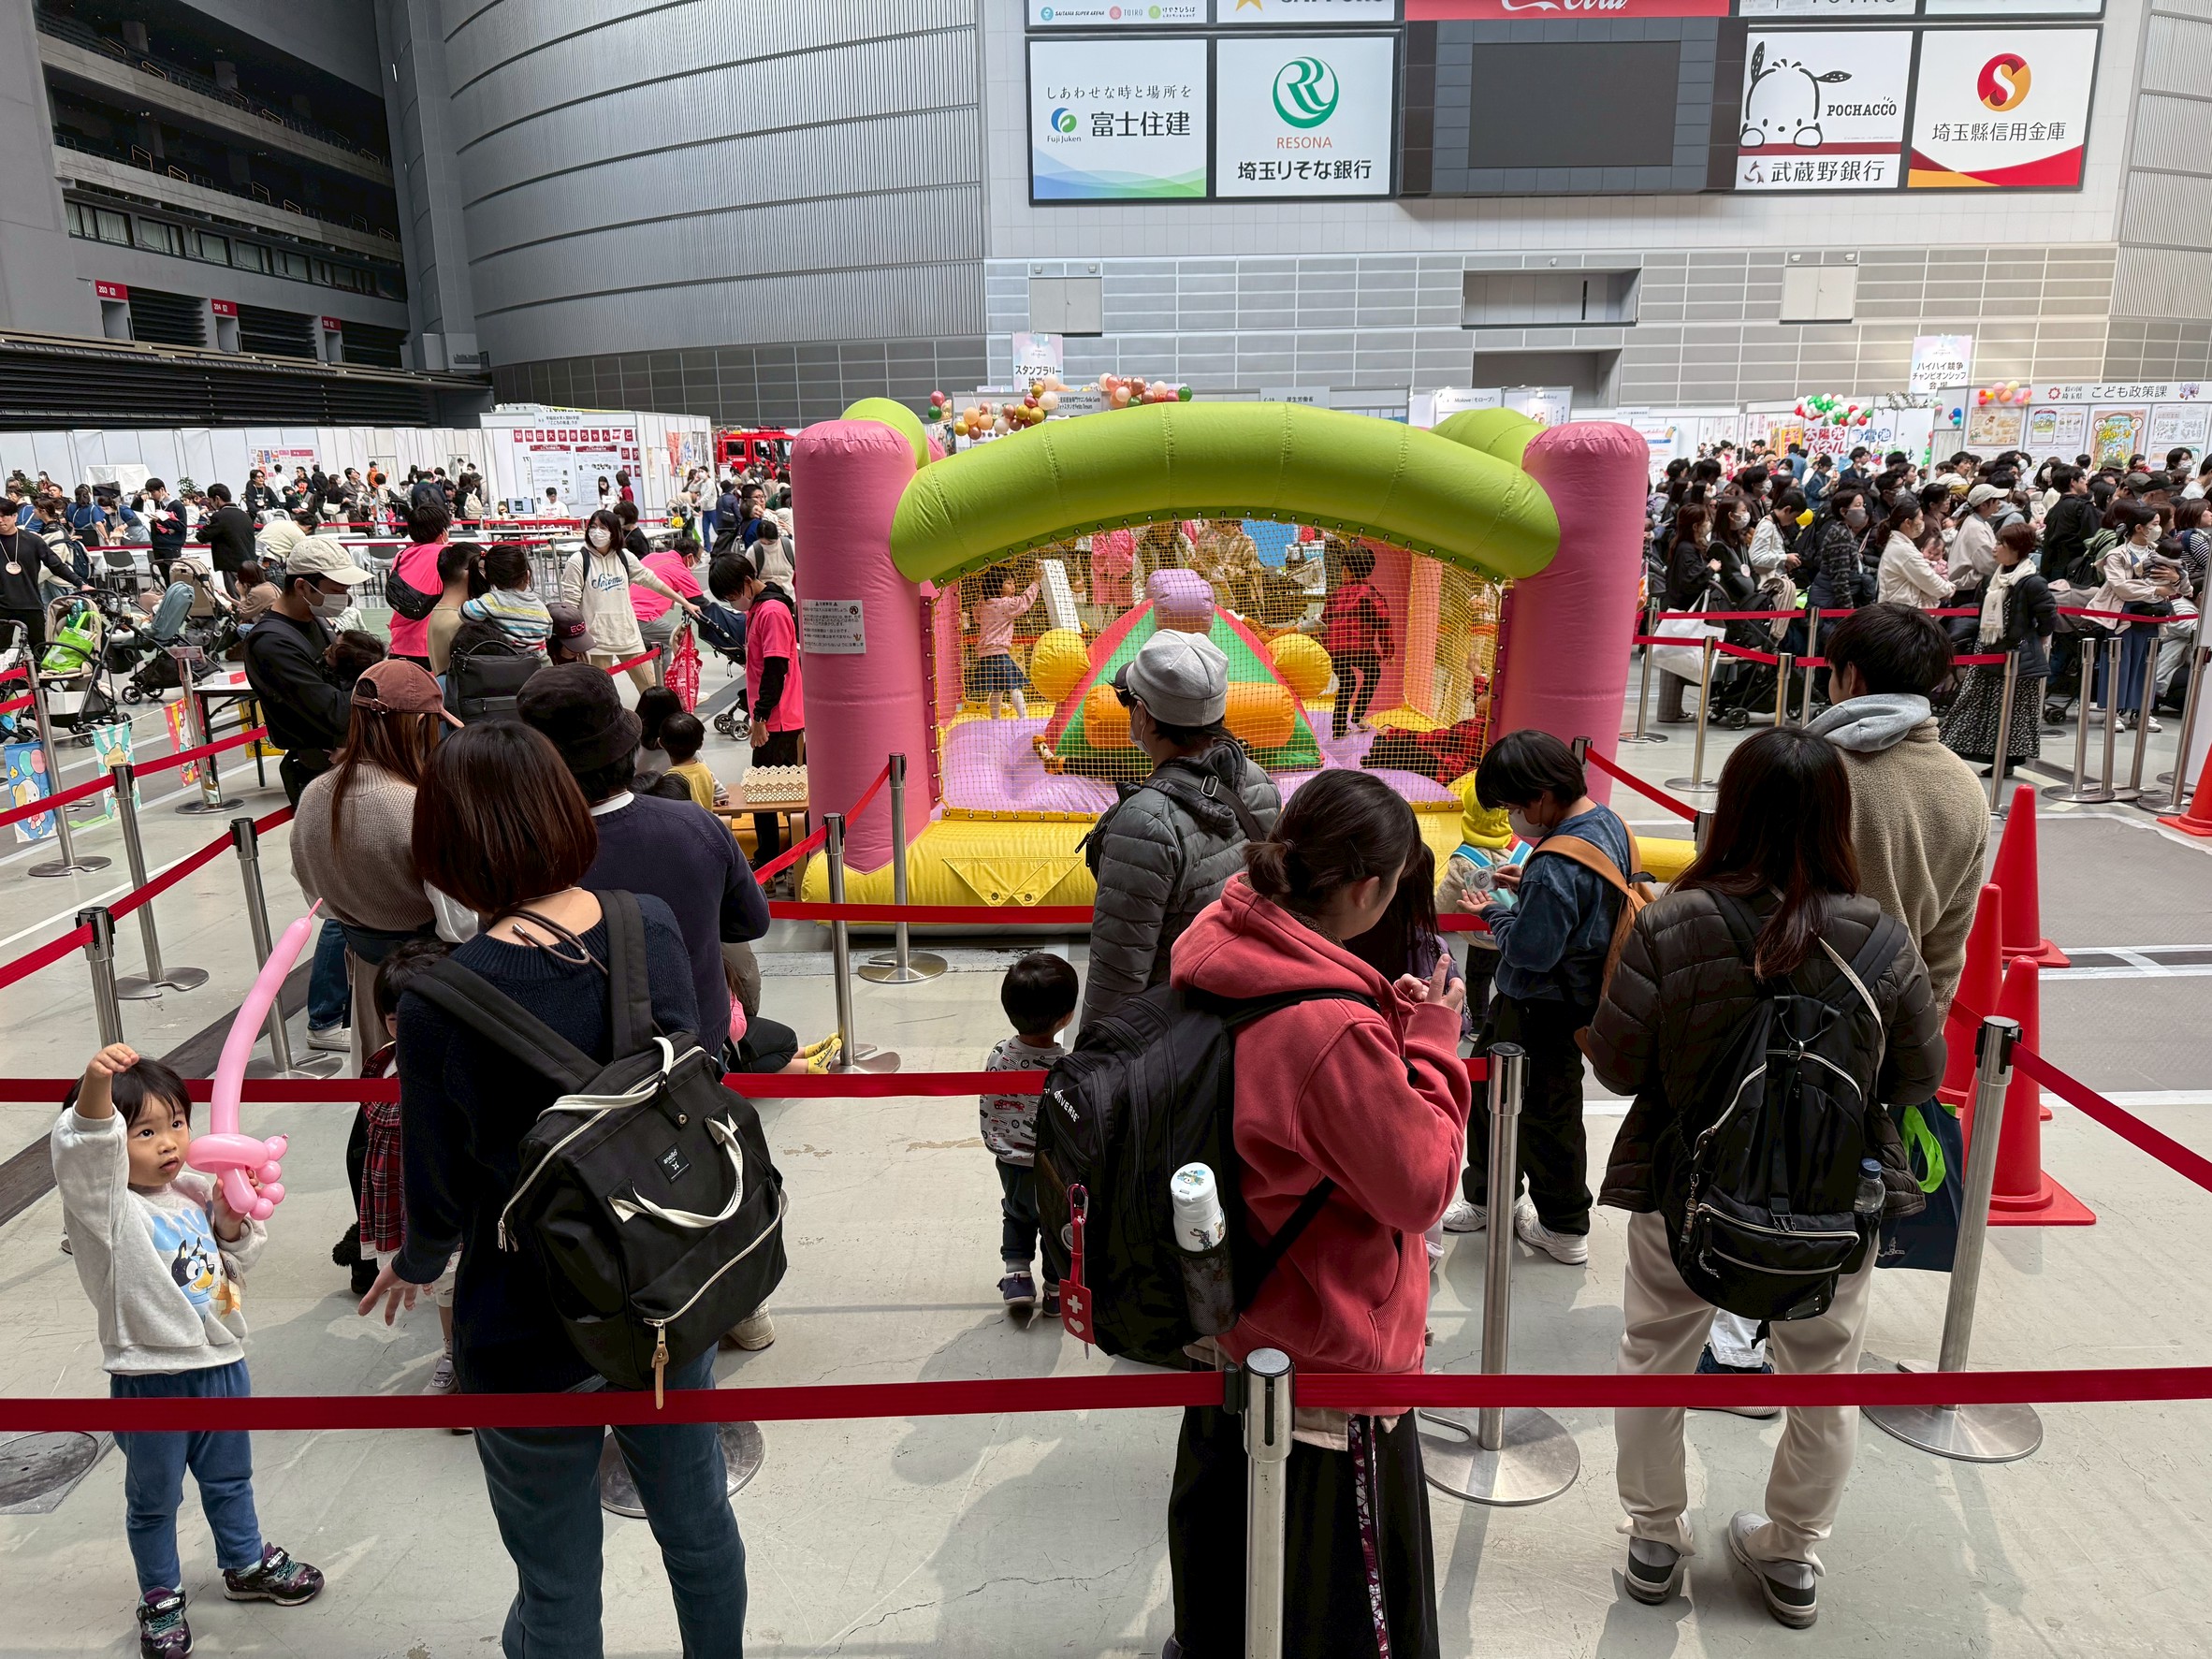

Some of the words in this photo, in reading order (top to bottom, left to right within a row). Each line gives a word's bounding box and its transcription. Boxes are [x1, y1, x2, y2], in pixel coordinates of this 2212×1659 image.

[1046, 85, 1191, 100] しあわせな時と場所を
[1826, 103, 1898, 118] POCHACCO
[1090, 110, 1191, 138] 富士住建
[1931, 121, 2067, 142] 埼玉縣信用金庫
[1276, 137, 1333, 150] RESONA
[1237, 159, 1373, 182] 埼玉りそな銀行
[1770, 159, 1885, 183] 武蔵野銀行
[2091, 385, 2168, 399] こども政策課
[1804, 427, 1845, 442] 太陽光
[1807, 442, 1845, 454] パネル
